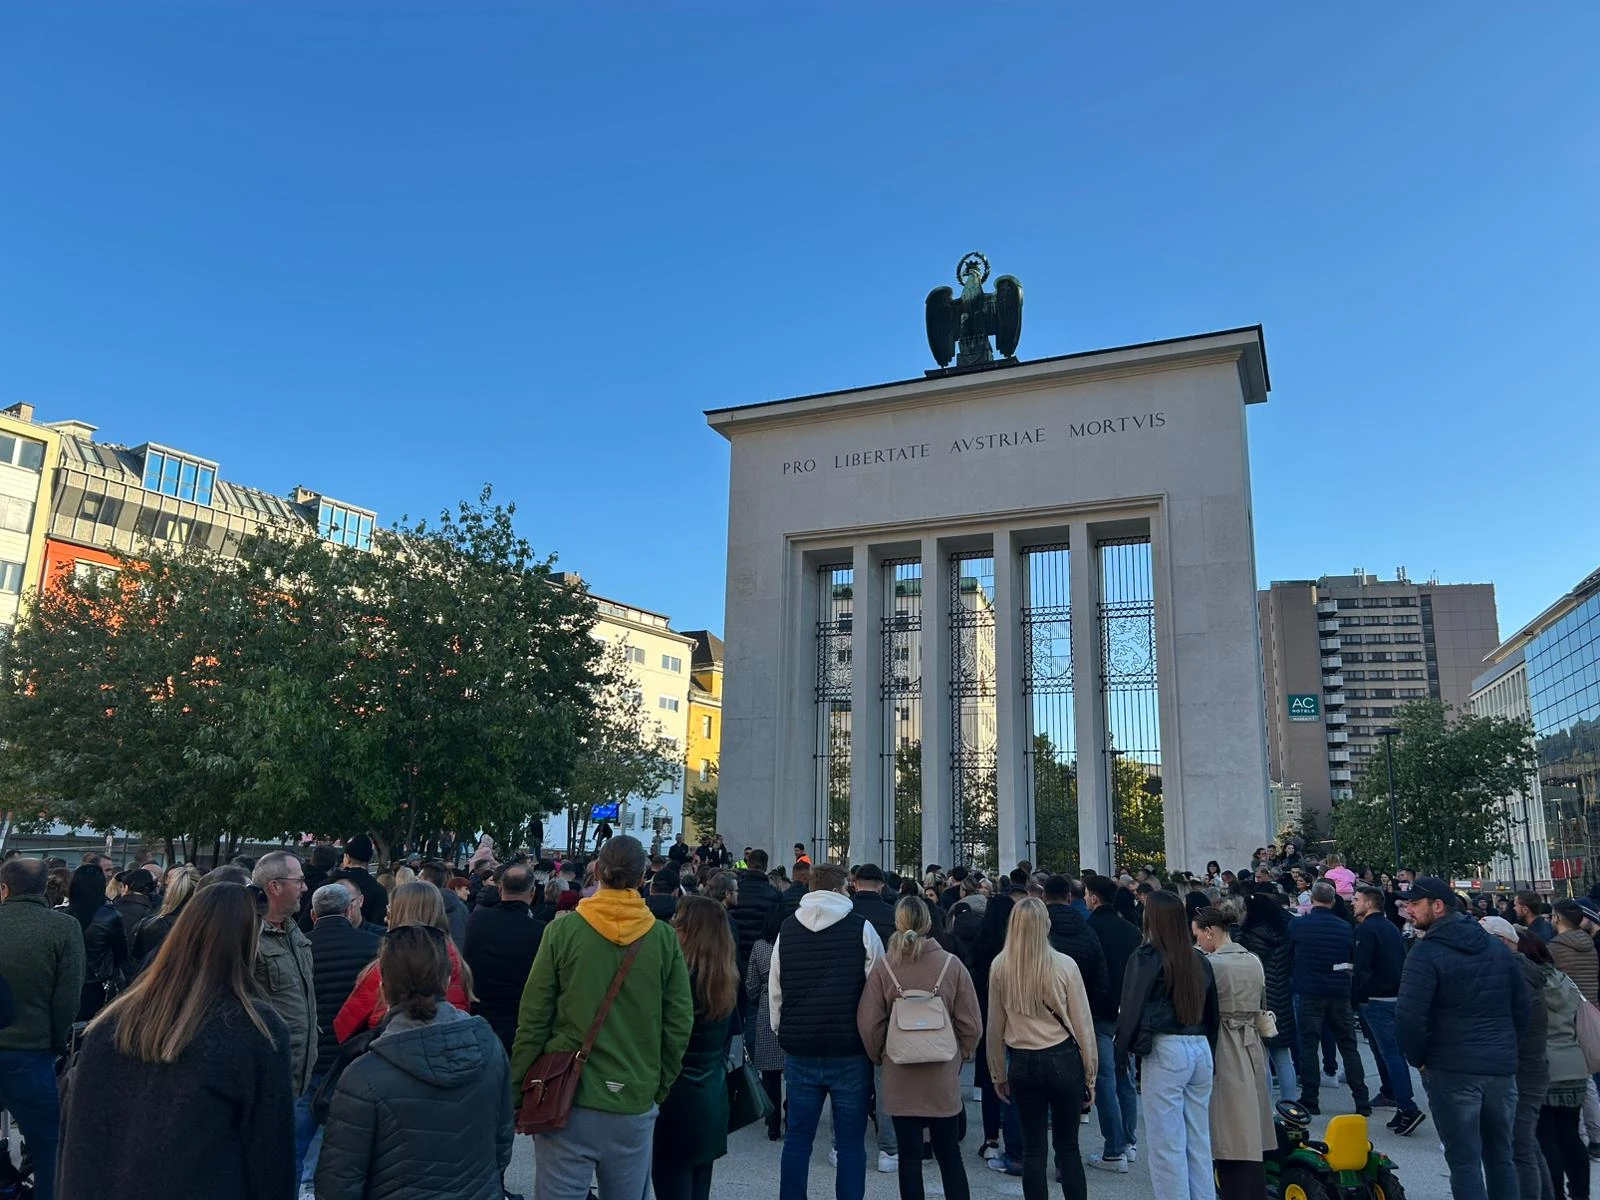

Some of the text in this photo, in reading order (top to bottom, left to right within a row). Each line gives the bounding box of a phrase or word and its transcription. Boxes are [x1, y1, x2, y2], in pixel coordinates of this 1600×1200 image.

[783, 412, 1166, 475] PRO LIBERTATE AVSTRIAE MORTVIS
[1292, 697, 1314, 709] AC
